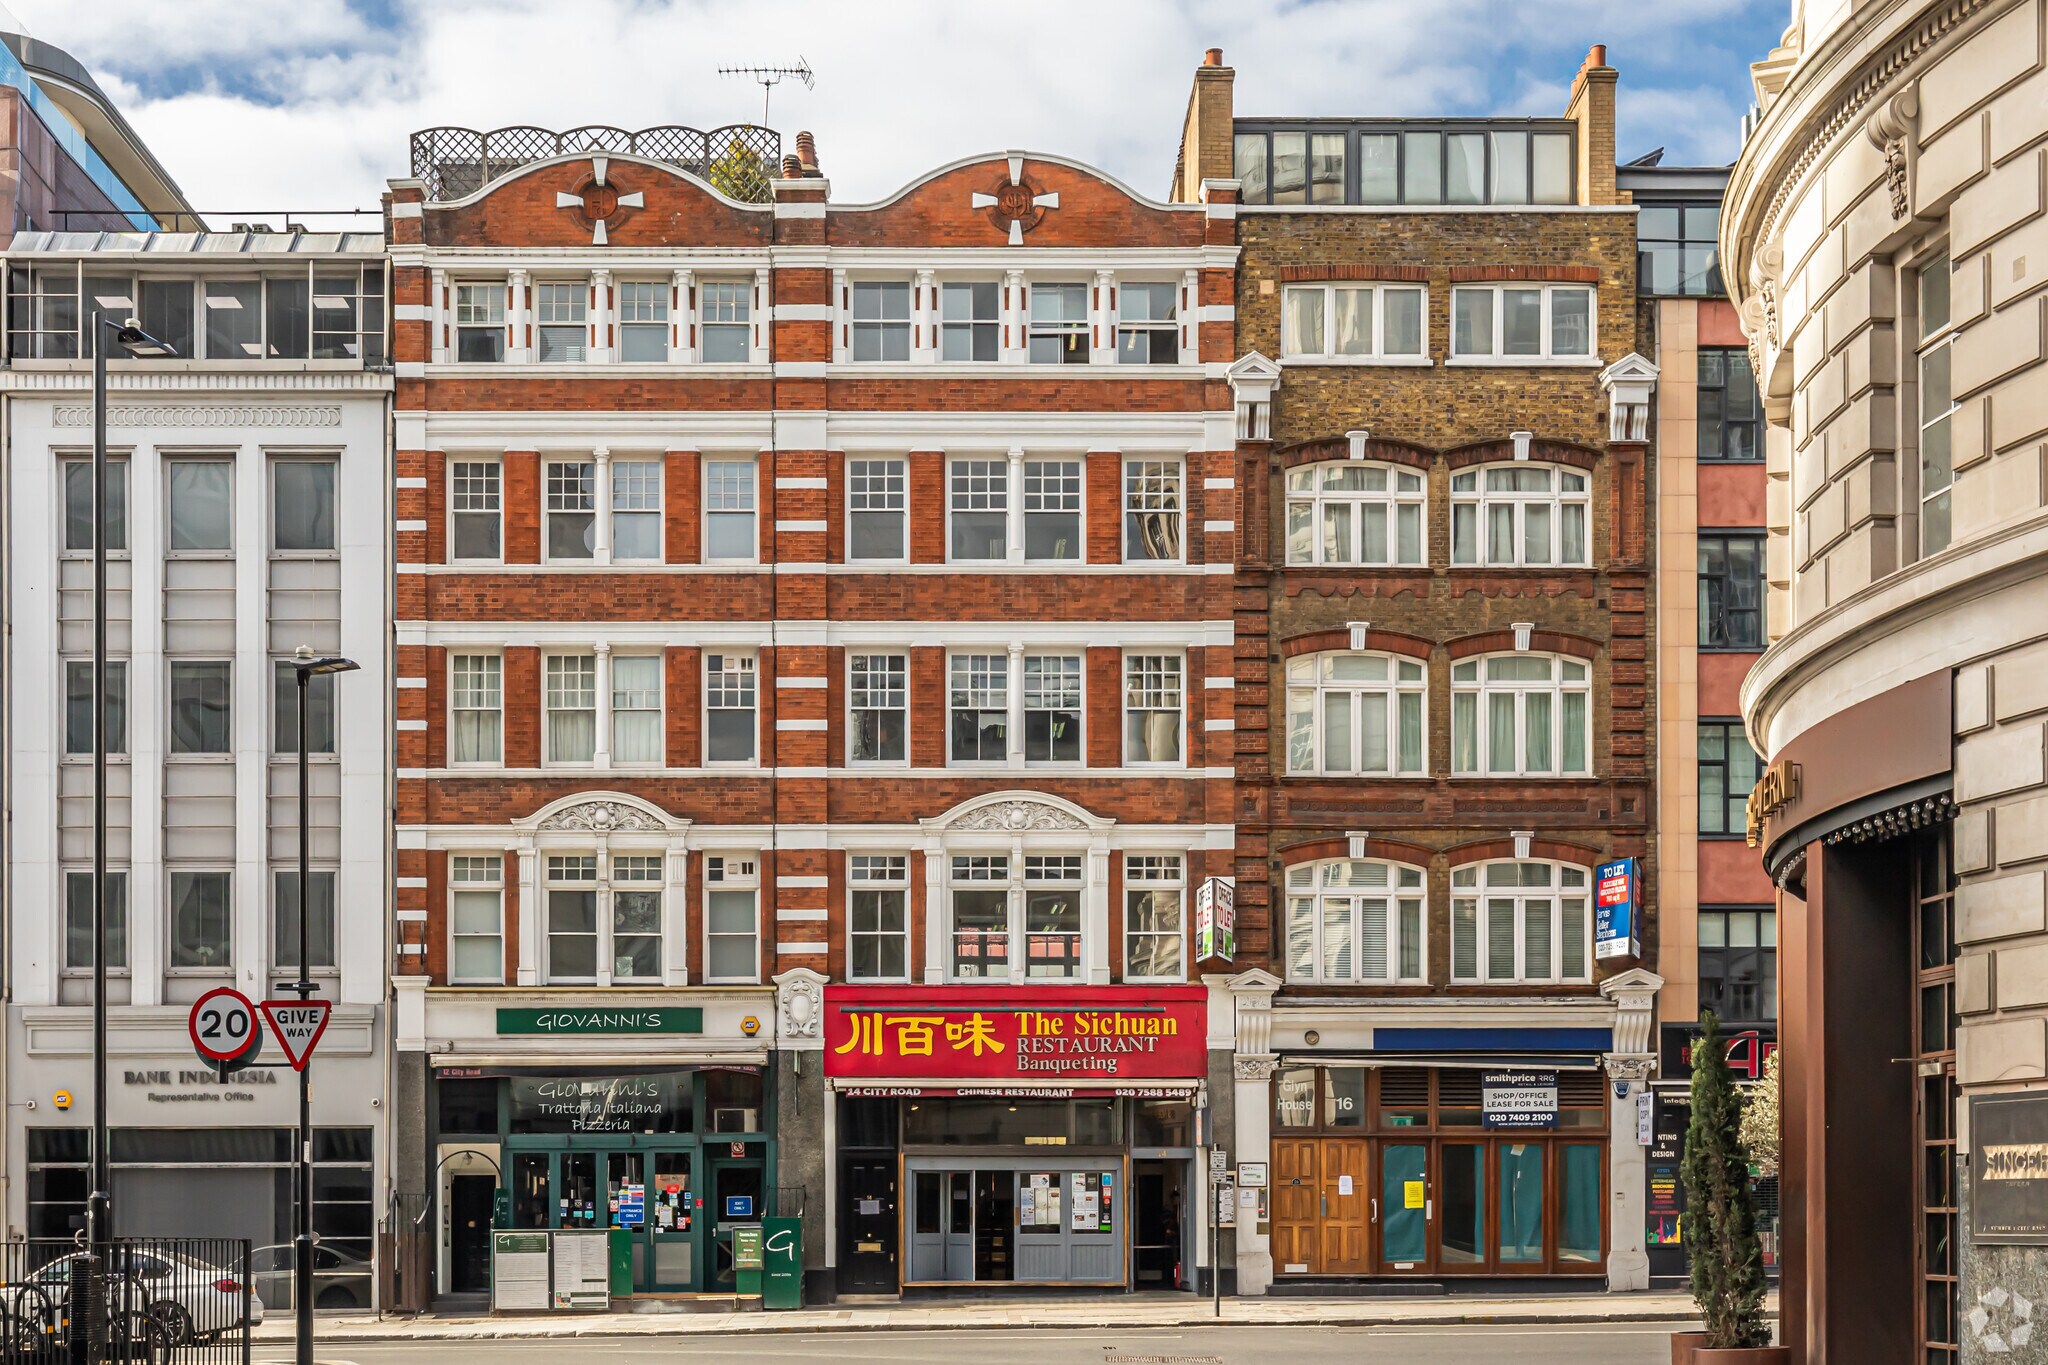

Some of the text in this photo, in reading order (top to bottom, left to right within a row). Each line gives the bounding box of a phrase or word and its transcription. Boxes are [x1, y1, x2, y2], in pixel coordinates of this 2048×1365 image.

[1604, 864, 1625, 878] TO LET
[201, 1009, 248, 1038] 20
[277, 1010, 318, 1024] GIVE
[536, 1013, 662, 1030] GIOVANNI'S
[1014, 1012, 1178, 1036] The Sichuan
[286, 1028, 312, 1037] WAY
[835, 1012, 1006, 1057] 川百味
[1016, 1036, 1159, 1055] RESTAURANT
[1016, 1055, 1118, 1074] Banqueting
[124, 1070, 171, 1084] BANK
[1485, 1074, 1536, 1084] smithprice
[847, 1087, 922, 1096] 14 CITY ROAD
[956, 1088, 1074, 1097] CHINESE RESTAURANT
[1115, 1088, 1192, 1097] 020 7588 5489
[1283, 1080, 1307, 1093] Glyn
[148, 1091, 254, 1103] Representative Office
[1335, 1097, 1353, 1110] 16
[538, 1102, 662, 1114] Trattoria Italiana
[1277, 1098, 1313, 1110] House
[1508, 1113, 1530, 1121] 7409
[1532, 1113, 1553, 1121] 2100
[571, 1118, 631, 1131] Pizzeria
[1652, 1150, 1675, 1158] DESIGN
